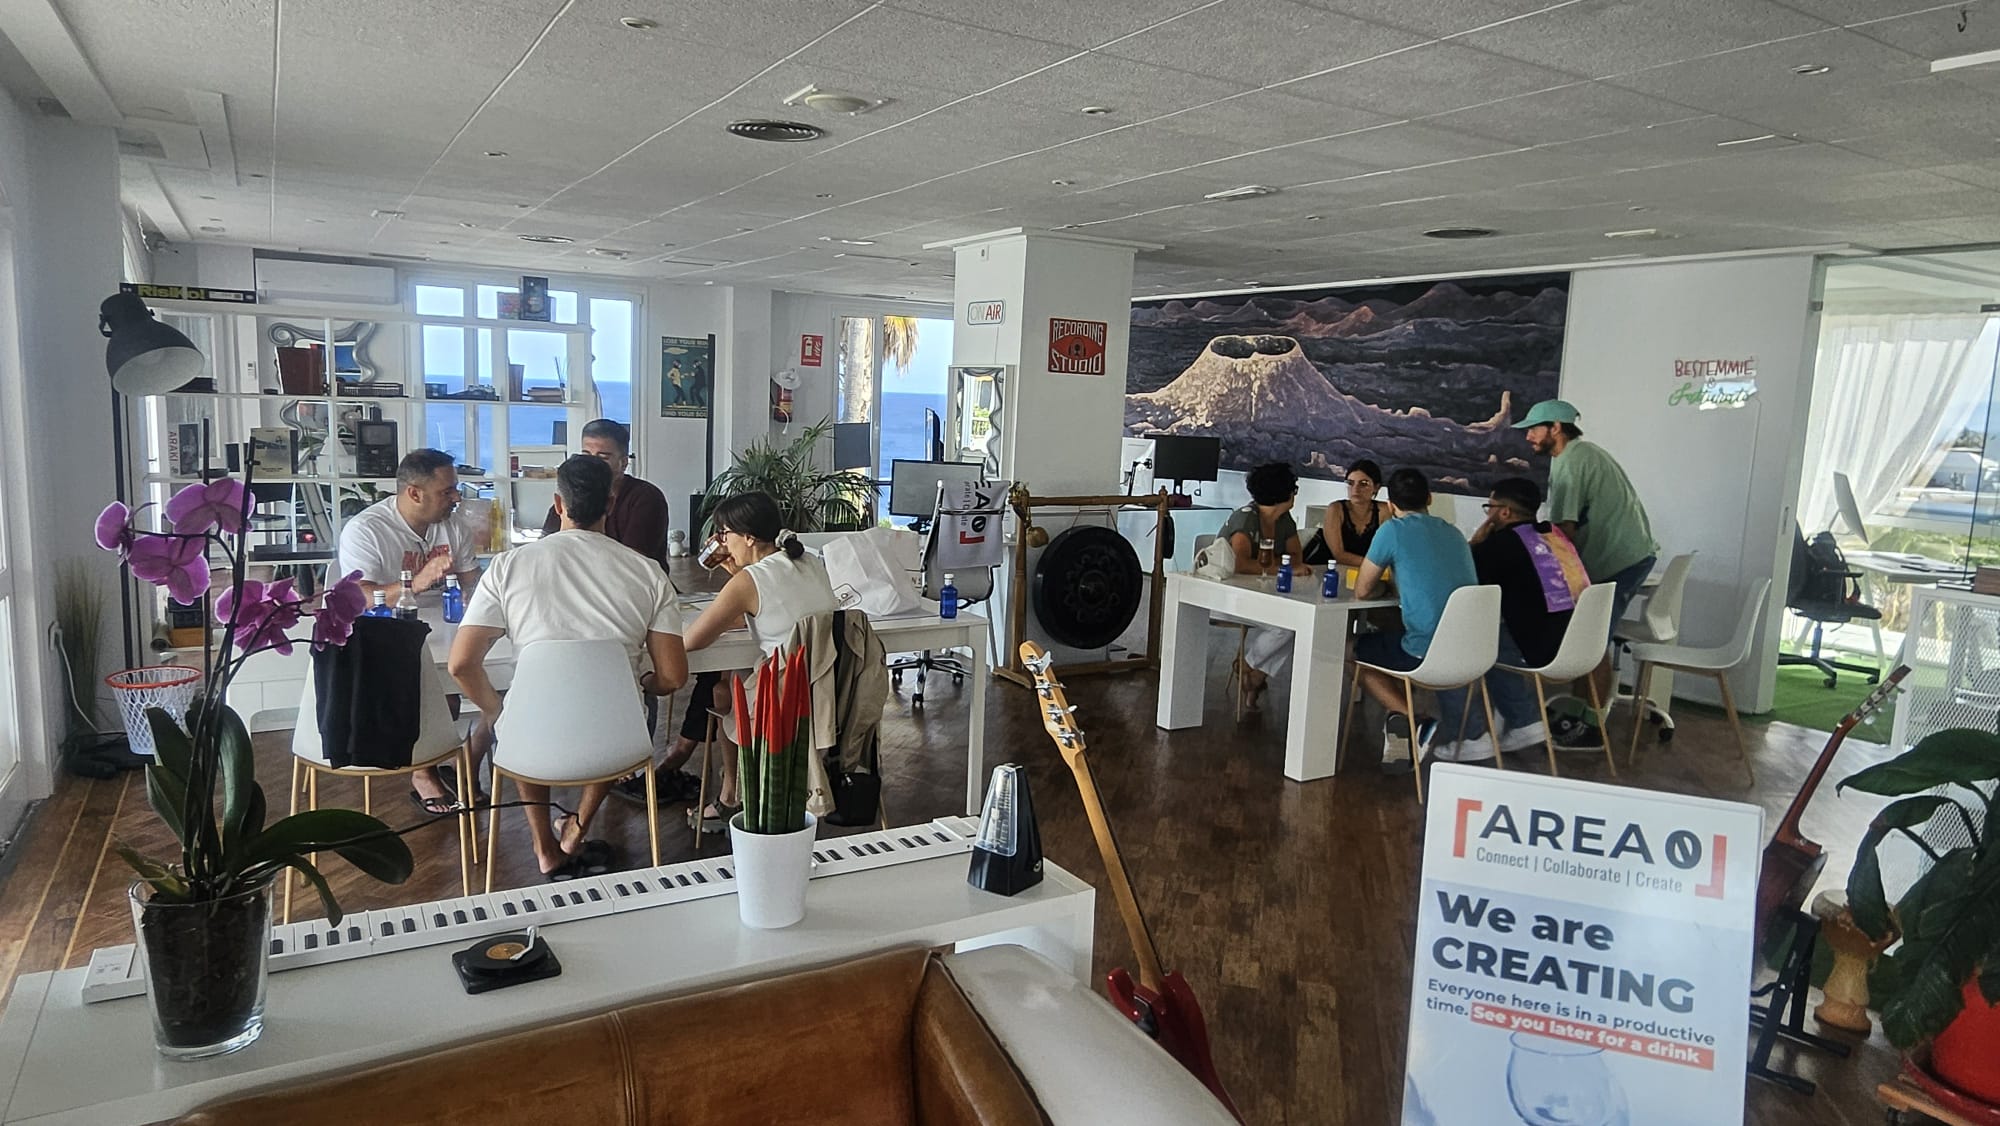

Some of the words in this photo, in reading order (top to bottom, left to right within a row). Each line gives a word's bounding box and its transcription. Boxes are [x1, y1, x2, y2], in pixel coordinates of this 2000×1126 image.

[985, 304, 1002, 320] AIR
[1052, 320, 1104, 347] RECORDING
[1051, 348, 1102, 373] STUDIO
[168, 431, 179, 462] ARAKI
[1478, 804, 1655, 865] AREA
[1476, 847, 1529, 869] Connect
[1543, 856, 1621, 883] Collaborate
[1635, 872, 1683, 893] Create
[1436, 890, 1516, 934] We
[1531, 914, 1615, 951] are
[1432, 936, 1696, 1014] CREATING
[1426, 997, 1469, 1017] time.
[1473, 1005, 1507, 1024] See
[1510, 1012, 1546, 1033] you
[1549, 1019, 1595, 1042] later
[1597, 1029, 1626, 1048] for
[1630, 1038, 1643, 1052] a
[1647, 1041, 1701, 1065] drink
[1428, 978, 1507, 1005] Everyone
[1511, 993, 1552, 1014] here
[1556, 1001, 1570, 1018] is
[1575, 1004, 1592, 1021] in
[1596, 1011, 1608, 1025] a
[1613, 1016, 1716, 1047] productive
